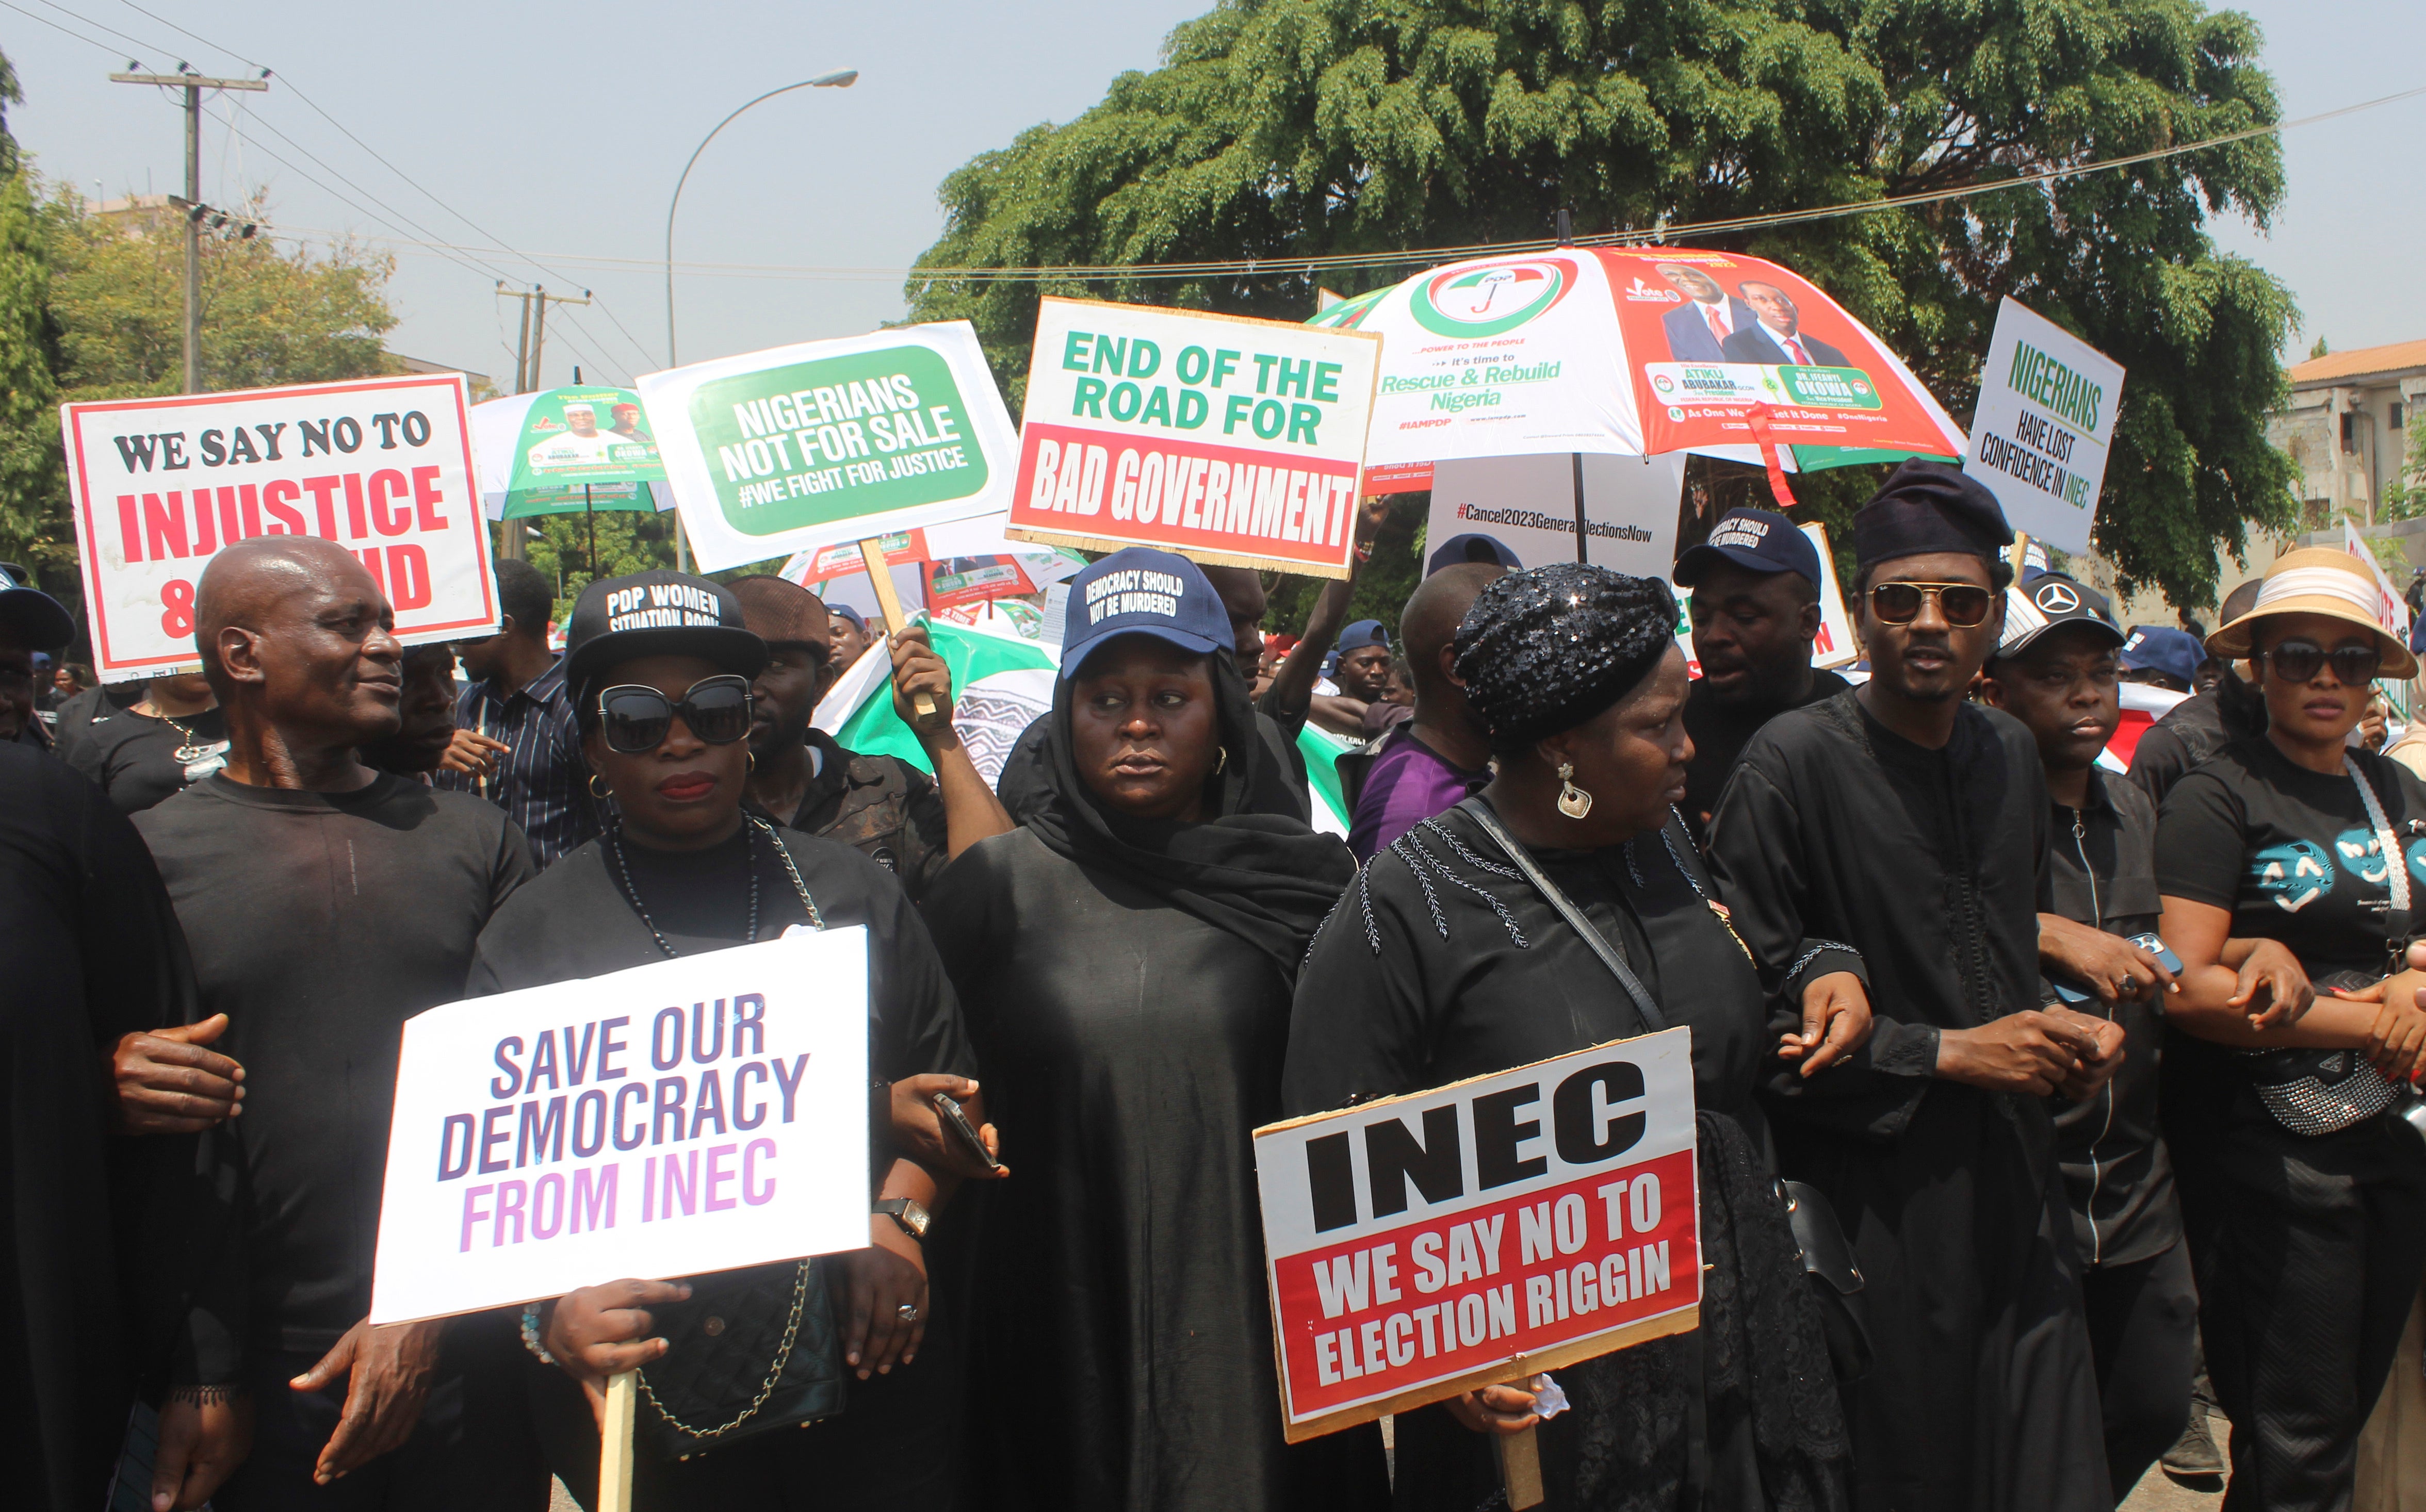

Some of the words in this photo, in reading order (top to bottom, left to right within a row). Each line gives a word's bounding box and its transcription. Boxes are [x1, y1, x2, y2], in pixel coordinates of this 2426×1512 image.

[1484, 275, 1513, 283] PDP
[1062, 331, 1161, 380] END
[1176, 346, 1241, 389] OF
[1253, 353, 1343, 404] THE
[1474, 355, 1500, 364] time
[1491, 338, 1526, 347] PEOPLE
[1381, 372, 1455, 393] Rescue
[1461, 368, 1479, 386] &
[1485, 361, 1561, 384] Rebuild
[1430, 388, 1501, 413] Nigeria
[1681, 380, 1737, 390] ABUBAKAR
[1685, 369, 1724, 380] ATIKU
[1795, 381, 1853, 397] OKOWA
[1796, 372, 1811, 381] DR.
[1812, 373, 1842, 382] IFEANYI
[2007, 339, 2102, 433] NIGERIANS
[732, 373, 920, 439] NIGERIANS
[1072, 376, 1209, 430] ROAD
[1223, 396, 1322, 446] FOR
[1399, 418, 1452, 430] #IAMPDP
[1688, 409, 1702, 418] As
[1703, 408, 1725, 417] One
[1726, 408, 1745, 417] We
[1790, 410, 1800, 419] It
[1800, 410, 1829, 420] Done
[1837, 413, 1888, 422] #OneNigeria
[115, 433, 189, 473] WE
[201, 422, 287, 467] SAY
[299, 416, 363, 458] NO
[372, 410, 431, 450] TO
[719, 433, 792, 483] NOT
[795, 421, 870, 466] FOR
[869, 405, 961, 453] SALE
[2016, 409, 2048, 452] HAVE
[2045, 425, 2076, 464] LOST
[738, 479, 788, 508] #WE
[786, 466, 845, 498] FIGHT
[845, 460, 888, 487] FOR
[889, 446, 969, 479] JUSTICE
[1030, 438, 1108, 516] BAD
[1111, 448, 1354, 547] GOVERNMENT
[1980, 432, 2053, 493] CONFIDENCE
[2051, 470, 2066, 499] IN
[2063, 472, 2090, 510] INEC
[117, 465, 448, 563] INJUSTICE
[1719, 532, 1760, 549] MURDERED
[1737, 518, 1769, 537] SHOULD
[606, 586, 645, 617] PDP
[649, 583, 720, 617] WOMEN
[1086, 570, 1140, 605] DEMOCRACY
[1143, 570, 1183, 597] SHOULD
[1089, 599, 1105, 627] NOT
[1106, 595, 1119, 618] BE
[1120, 592, 1177, 618] MURDERED
[491, 1016, 629, 1099] SAVE
[652, 993, 766, 1072] OUR
[437, 1053, 810, 1182] DEMOCRACY
[1306, 1061, 1647, 1234] INEC
[460, 1163, 619, 1253] FROM
[642, 1138, 777, 1224] INEC
[1312, 1243, 1402, 1320] WE
[1411, 1213, 1505, 1294] SAY
[1518, 1193, 1587, 1266] NO
[1598, 1173, 1662, 1242] TO
[1314, 1284, 1516, 1387] ELECTION
[1525, 1240, 1671, 1330] RIGGIN
